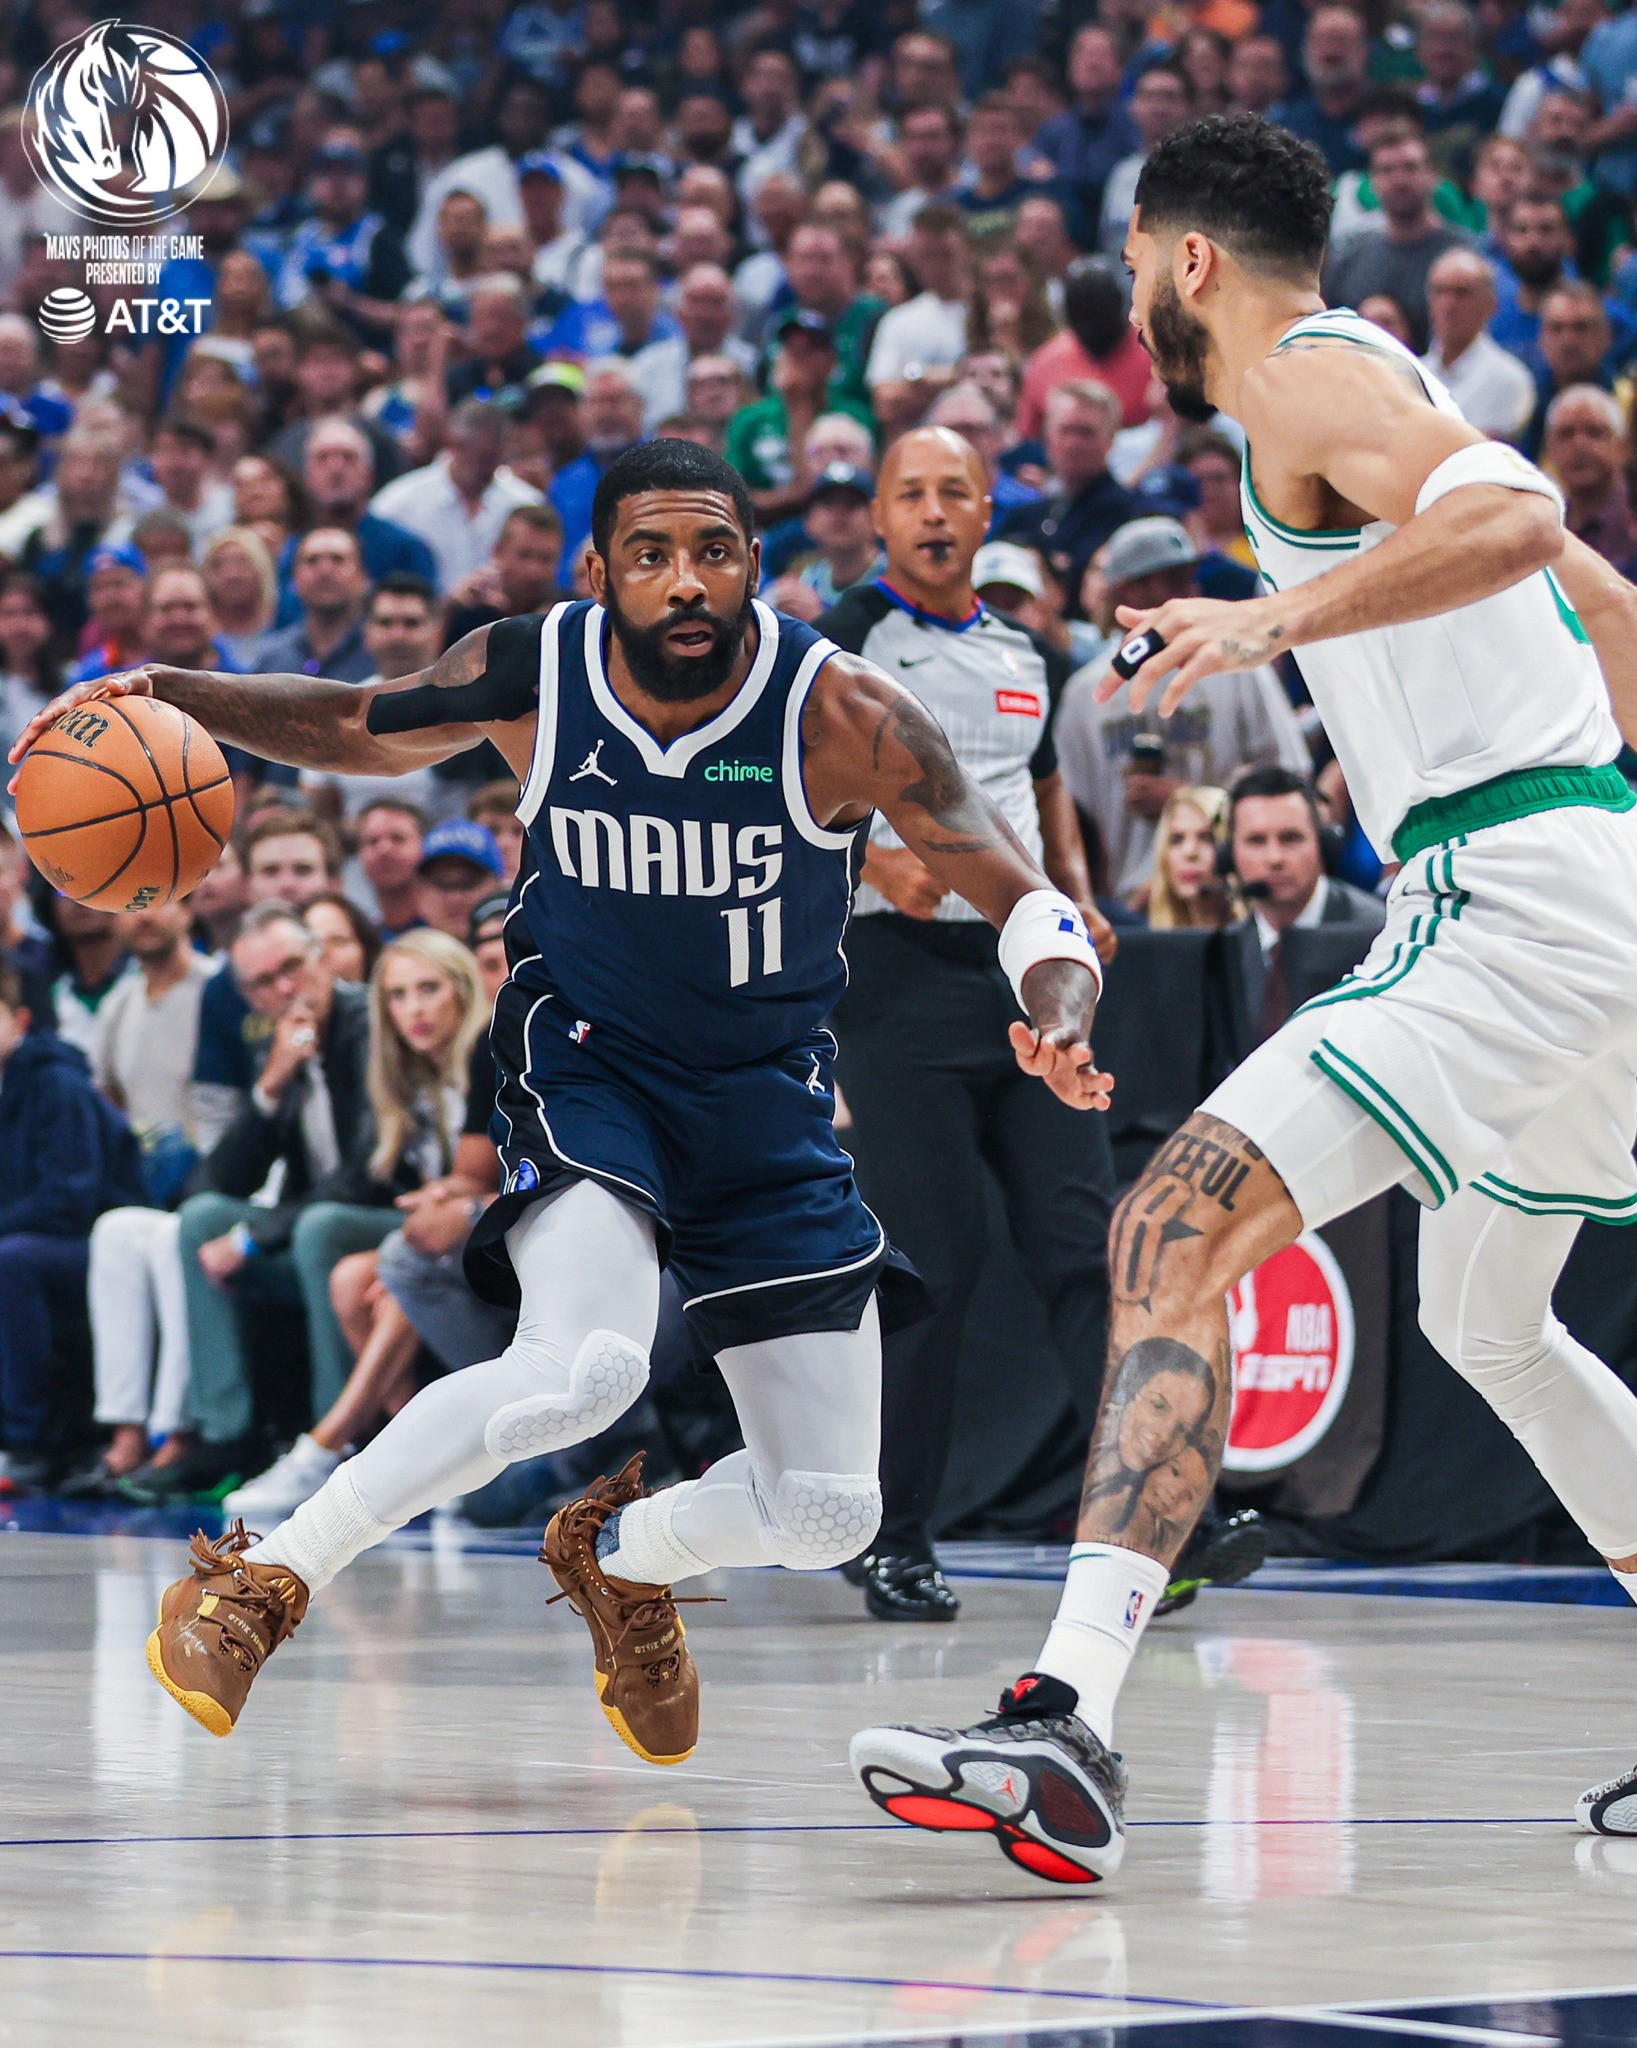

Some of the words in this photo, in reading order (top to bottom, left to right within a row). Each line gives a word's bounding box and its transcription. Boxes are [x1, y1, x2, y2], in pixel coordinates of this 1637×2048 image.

[704, 759, 773, 783] chime
[719, 896, 783, 988] 11
[1285, 1303, 1331, 1353] NBA
[1238, 1352, 1331, 1392] ESPN
